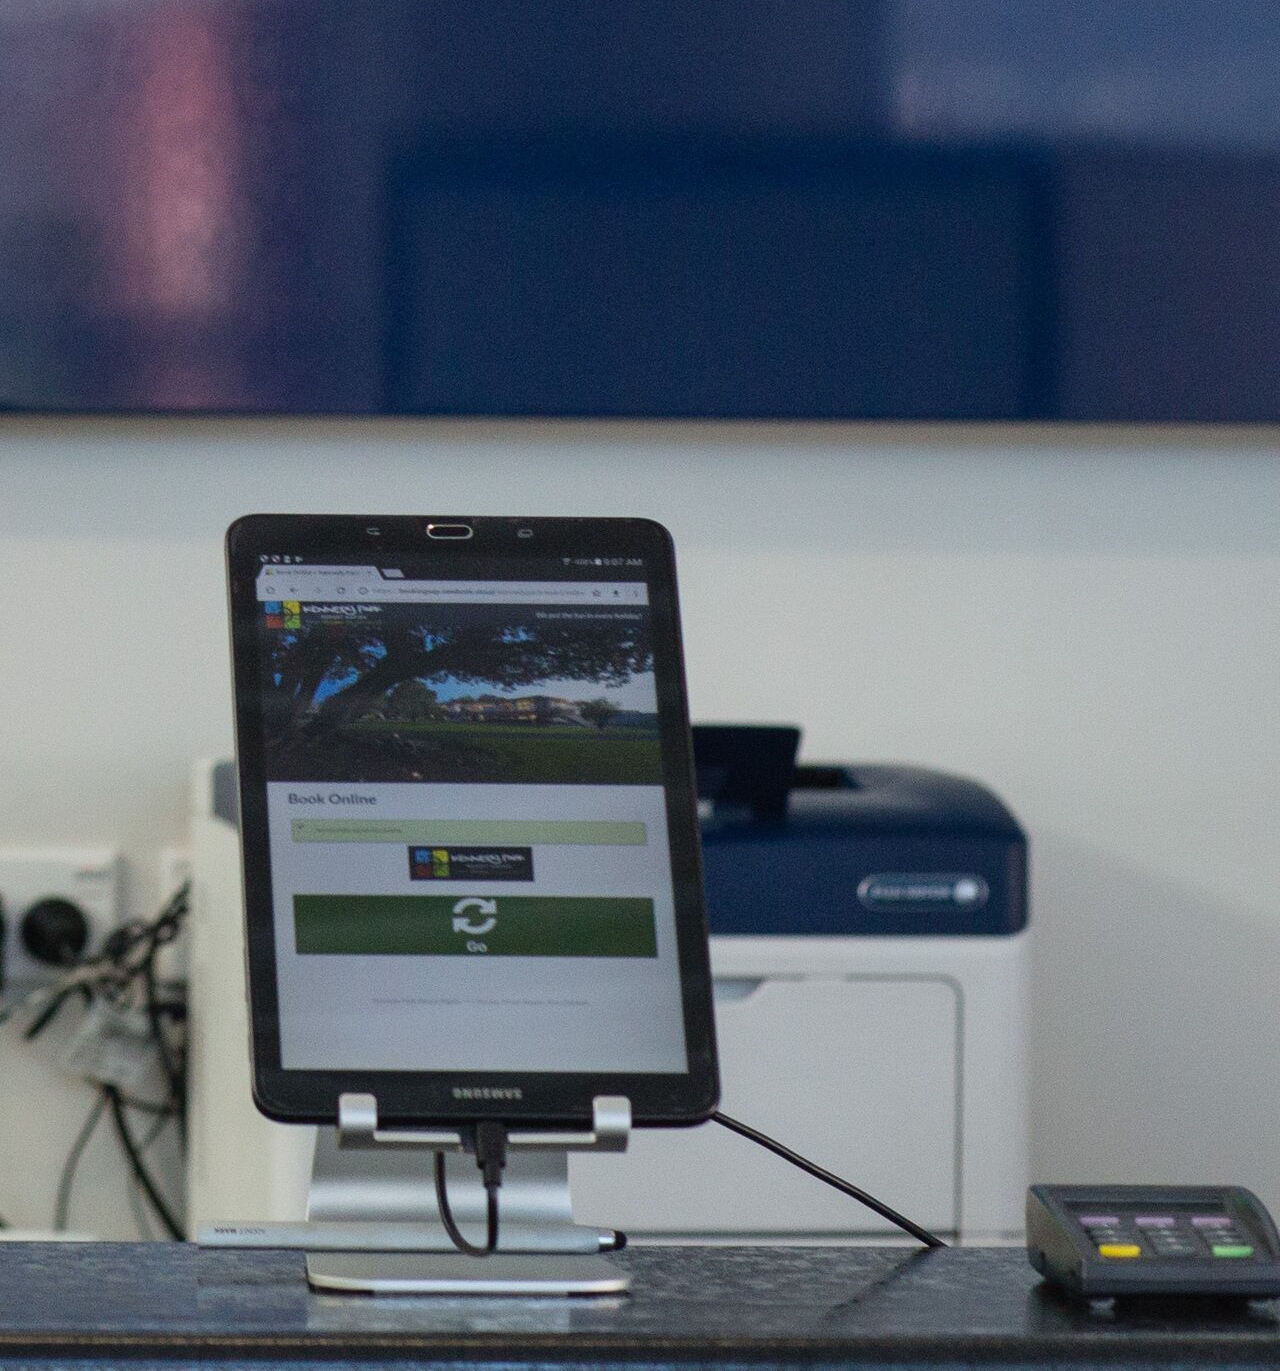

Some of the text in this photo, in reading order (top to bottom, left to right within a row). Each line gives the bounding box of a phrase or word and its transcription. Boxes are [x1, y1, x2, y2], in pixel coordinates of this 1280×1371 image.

[288, 793, 377, 806] Book Online
[466, 940, 488, 953] Go
